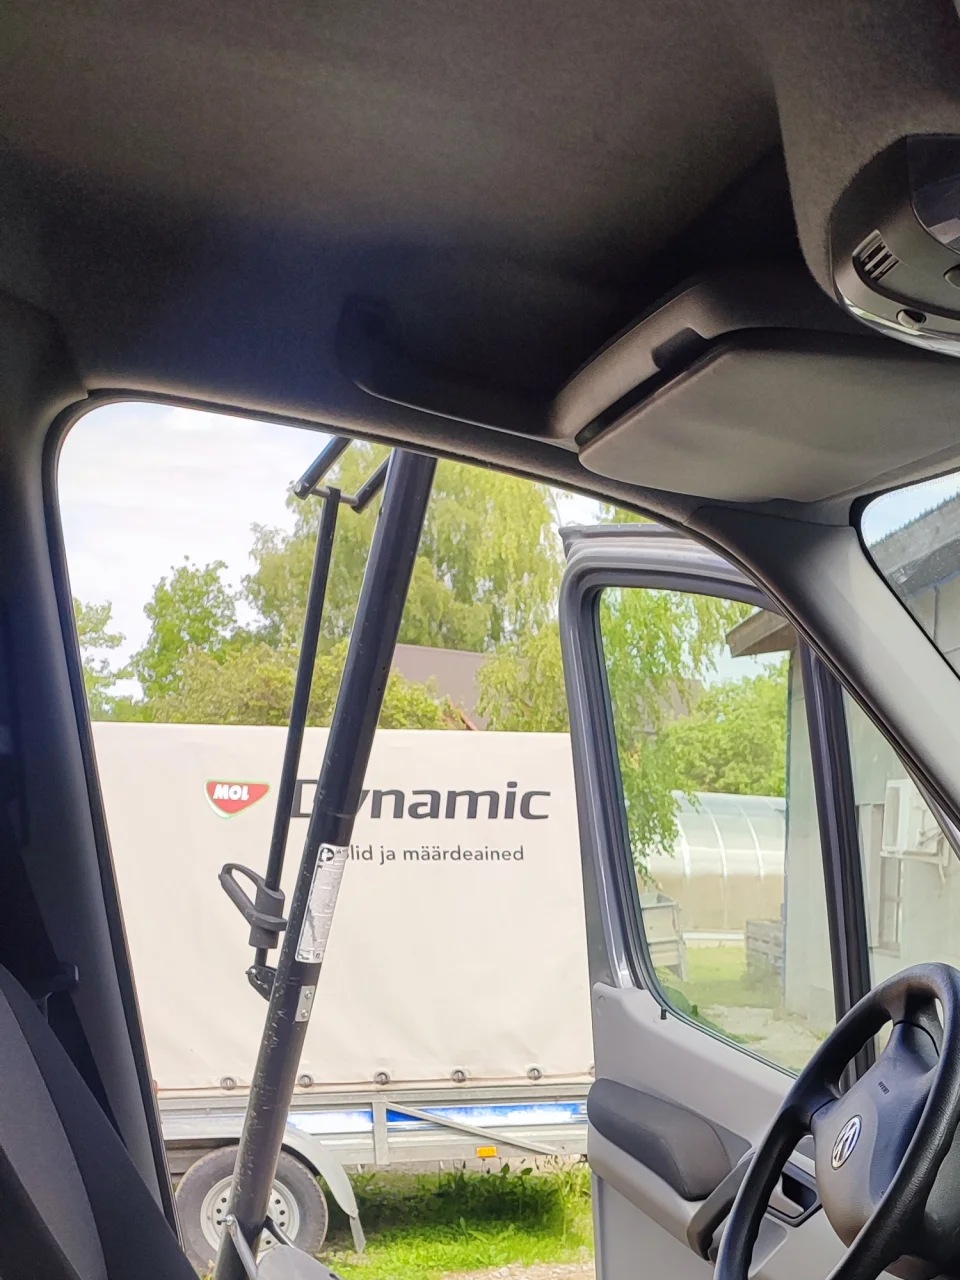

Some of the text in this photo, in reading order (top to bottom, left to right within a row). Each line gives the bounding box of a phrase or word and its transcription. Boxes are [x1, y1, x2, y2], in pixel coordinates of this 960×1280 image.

[213, 784, 249, 801] MOL
[346, 844, 524, 865] lid ja määrdeained
